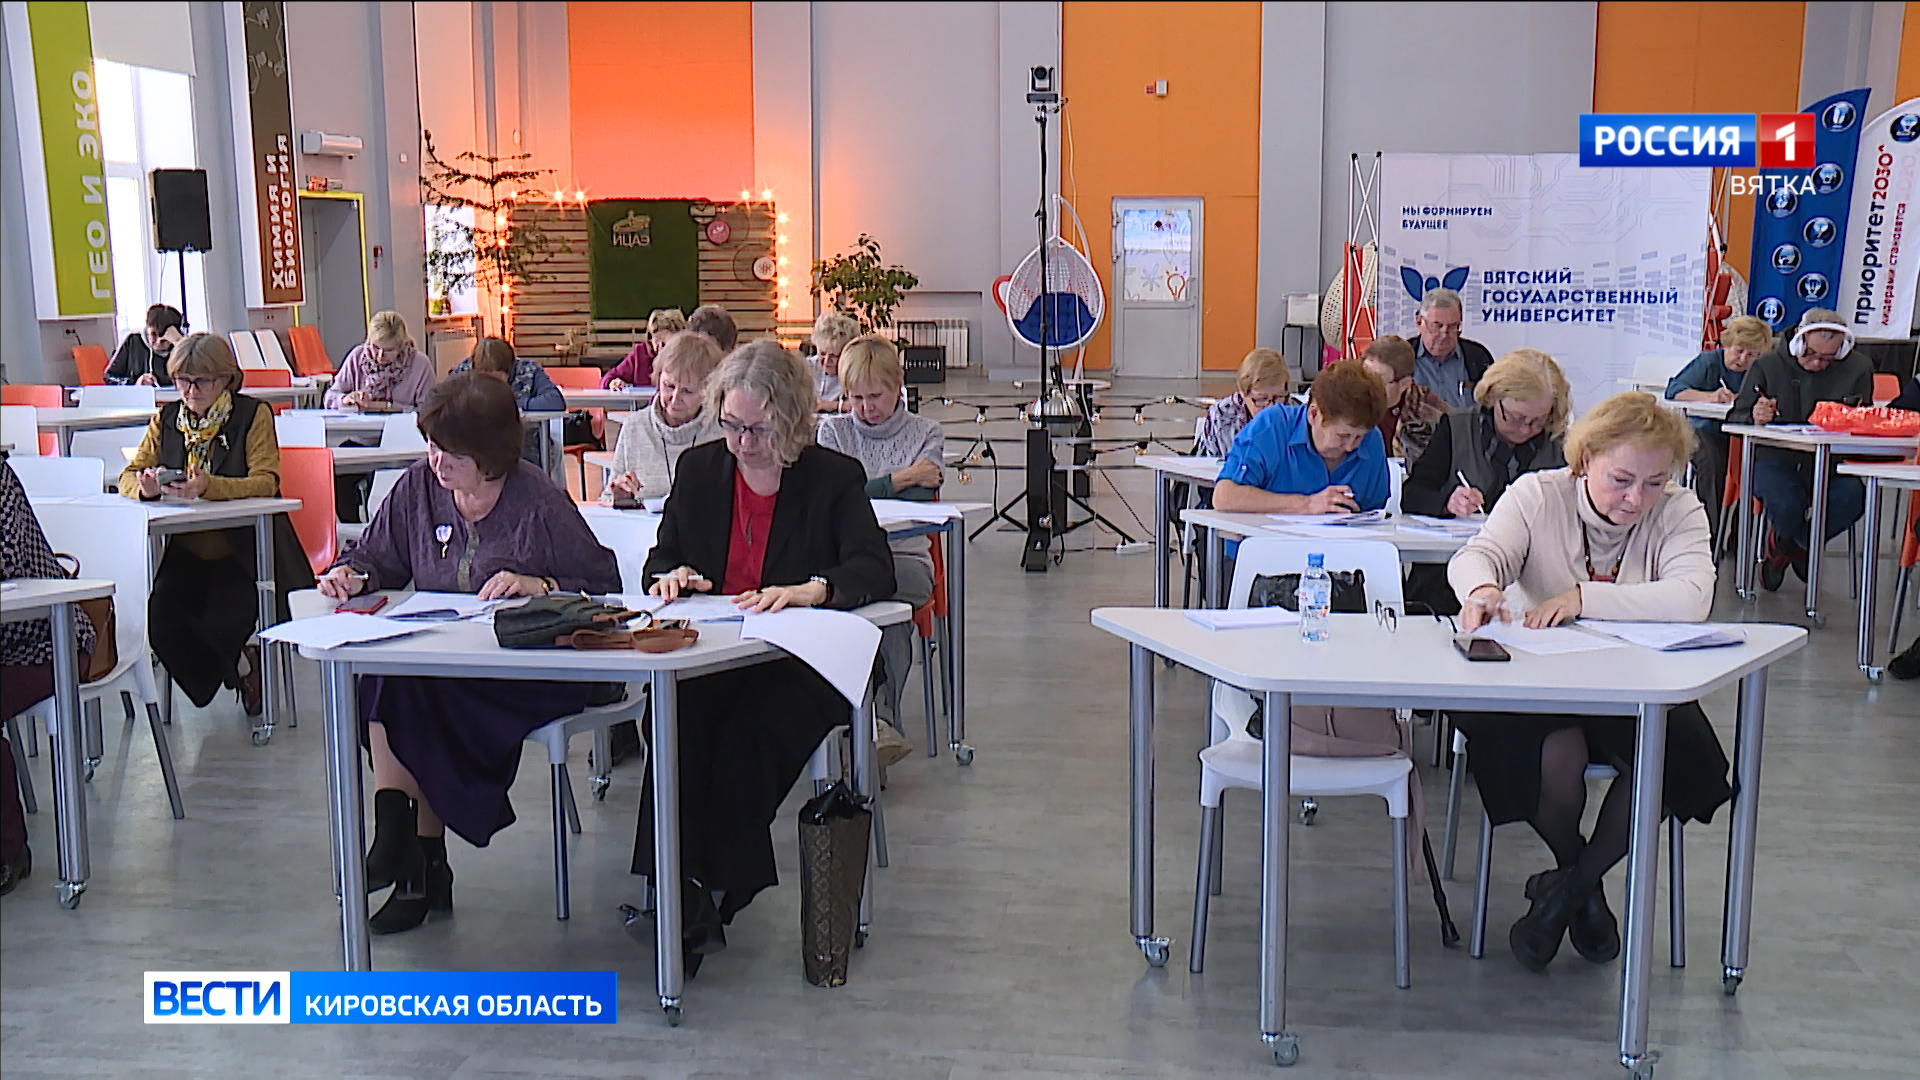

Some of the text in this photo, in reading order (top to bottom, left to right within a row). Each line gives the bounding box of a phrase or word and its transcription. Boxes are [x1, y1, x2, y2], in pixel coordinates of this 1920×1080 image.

[73, 71, 109, 299] ГЕО И ЭКО
[276, 134, 297, 289] БИОЛОГИЯ
[1422, 206, 1493, 216] ФОРМИРУЕМ
[265, 154, 286, 290] ХИМИЯ И
[1402, 219, 1449, 230] БУДУЩЕЕ
[1483, 267, 1572, 285] ВЯТСКИЙ
[1482, 287, 1679, 305] ГОСУДАРСТВЕННЫЙ
[1482, 308, 1616, 322] УНИВЕРСИТЕТ
